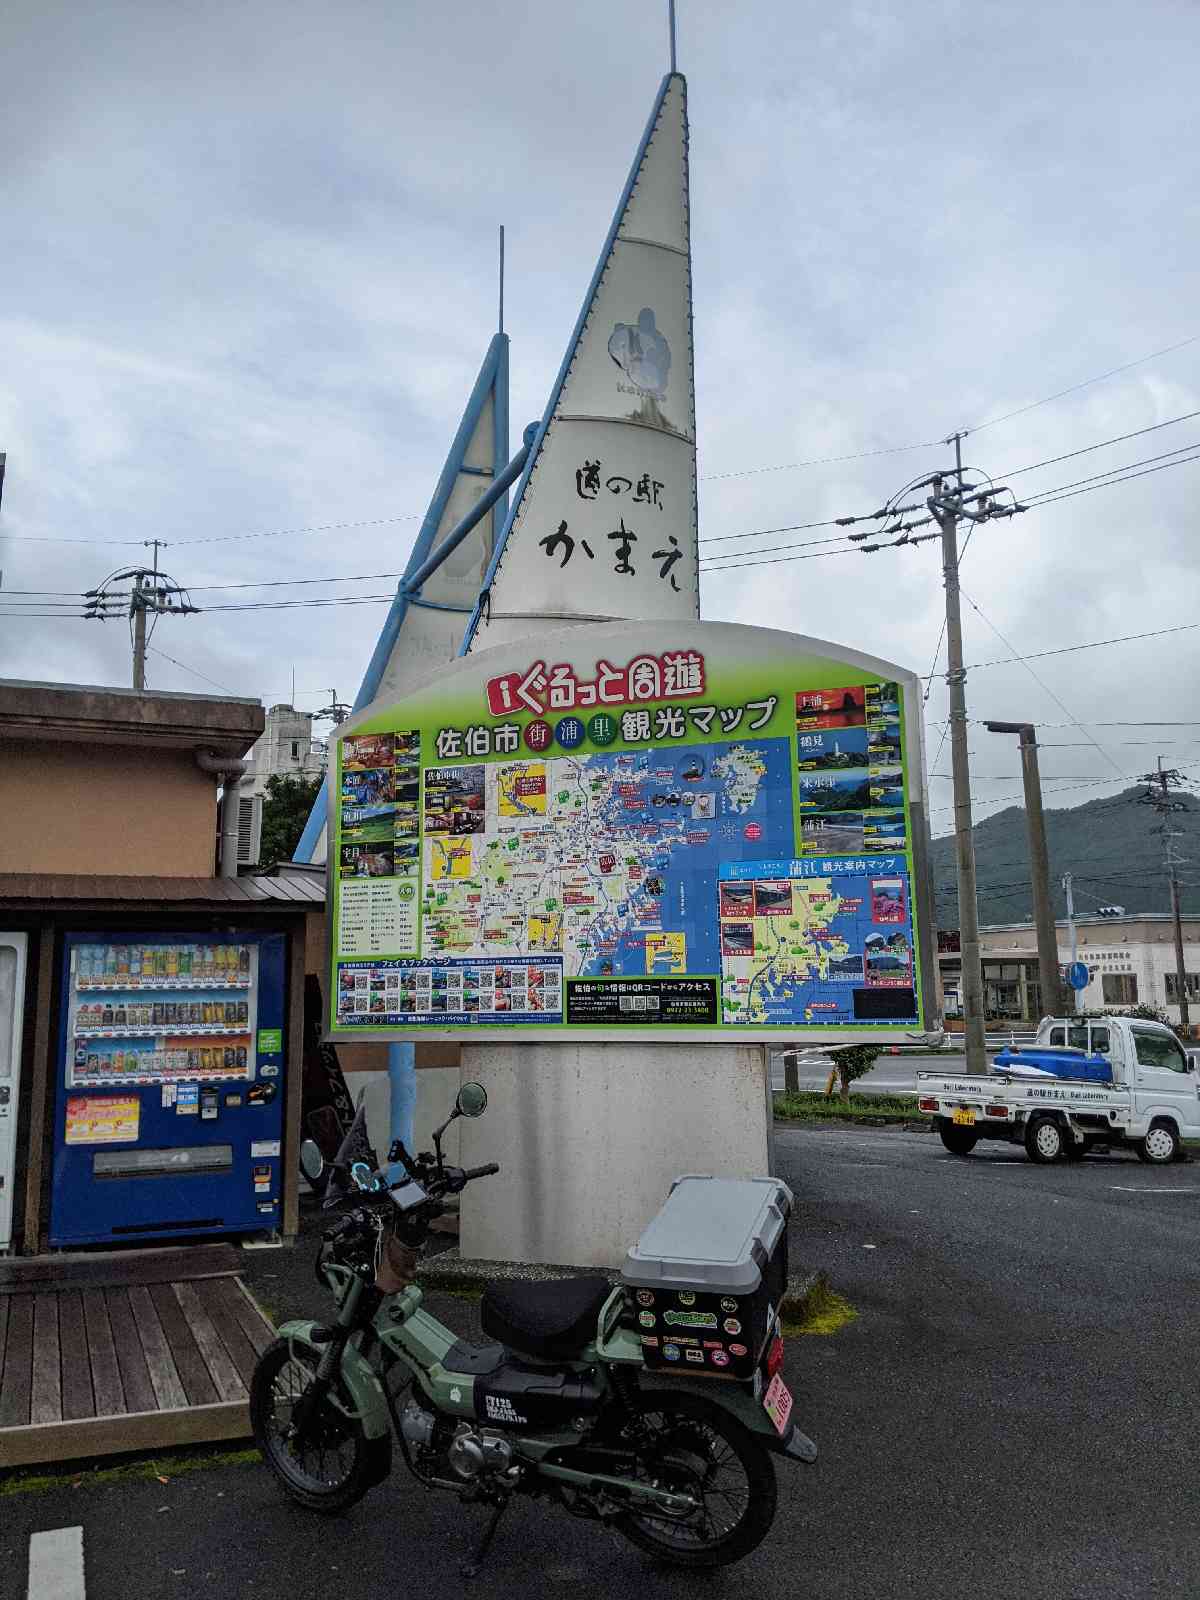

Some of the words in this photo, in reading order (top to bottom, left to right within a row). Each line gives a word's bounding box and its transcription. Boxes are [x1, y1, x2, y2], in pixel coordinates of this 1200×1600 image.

[576, 459, 665, 511] 道の駅
[539, 519, 683, 592] かまえ
[437, 724, 521, 757] 佐伯市
[560, 720, 578, 741] 浦
[621, 697, 776, 742] 観光マップ
[822, 858, 896, 872] 観光案内マップ
